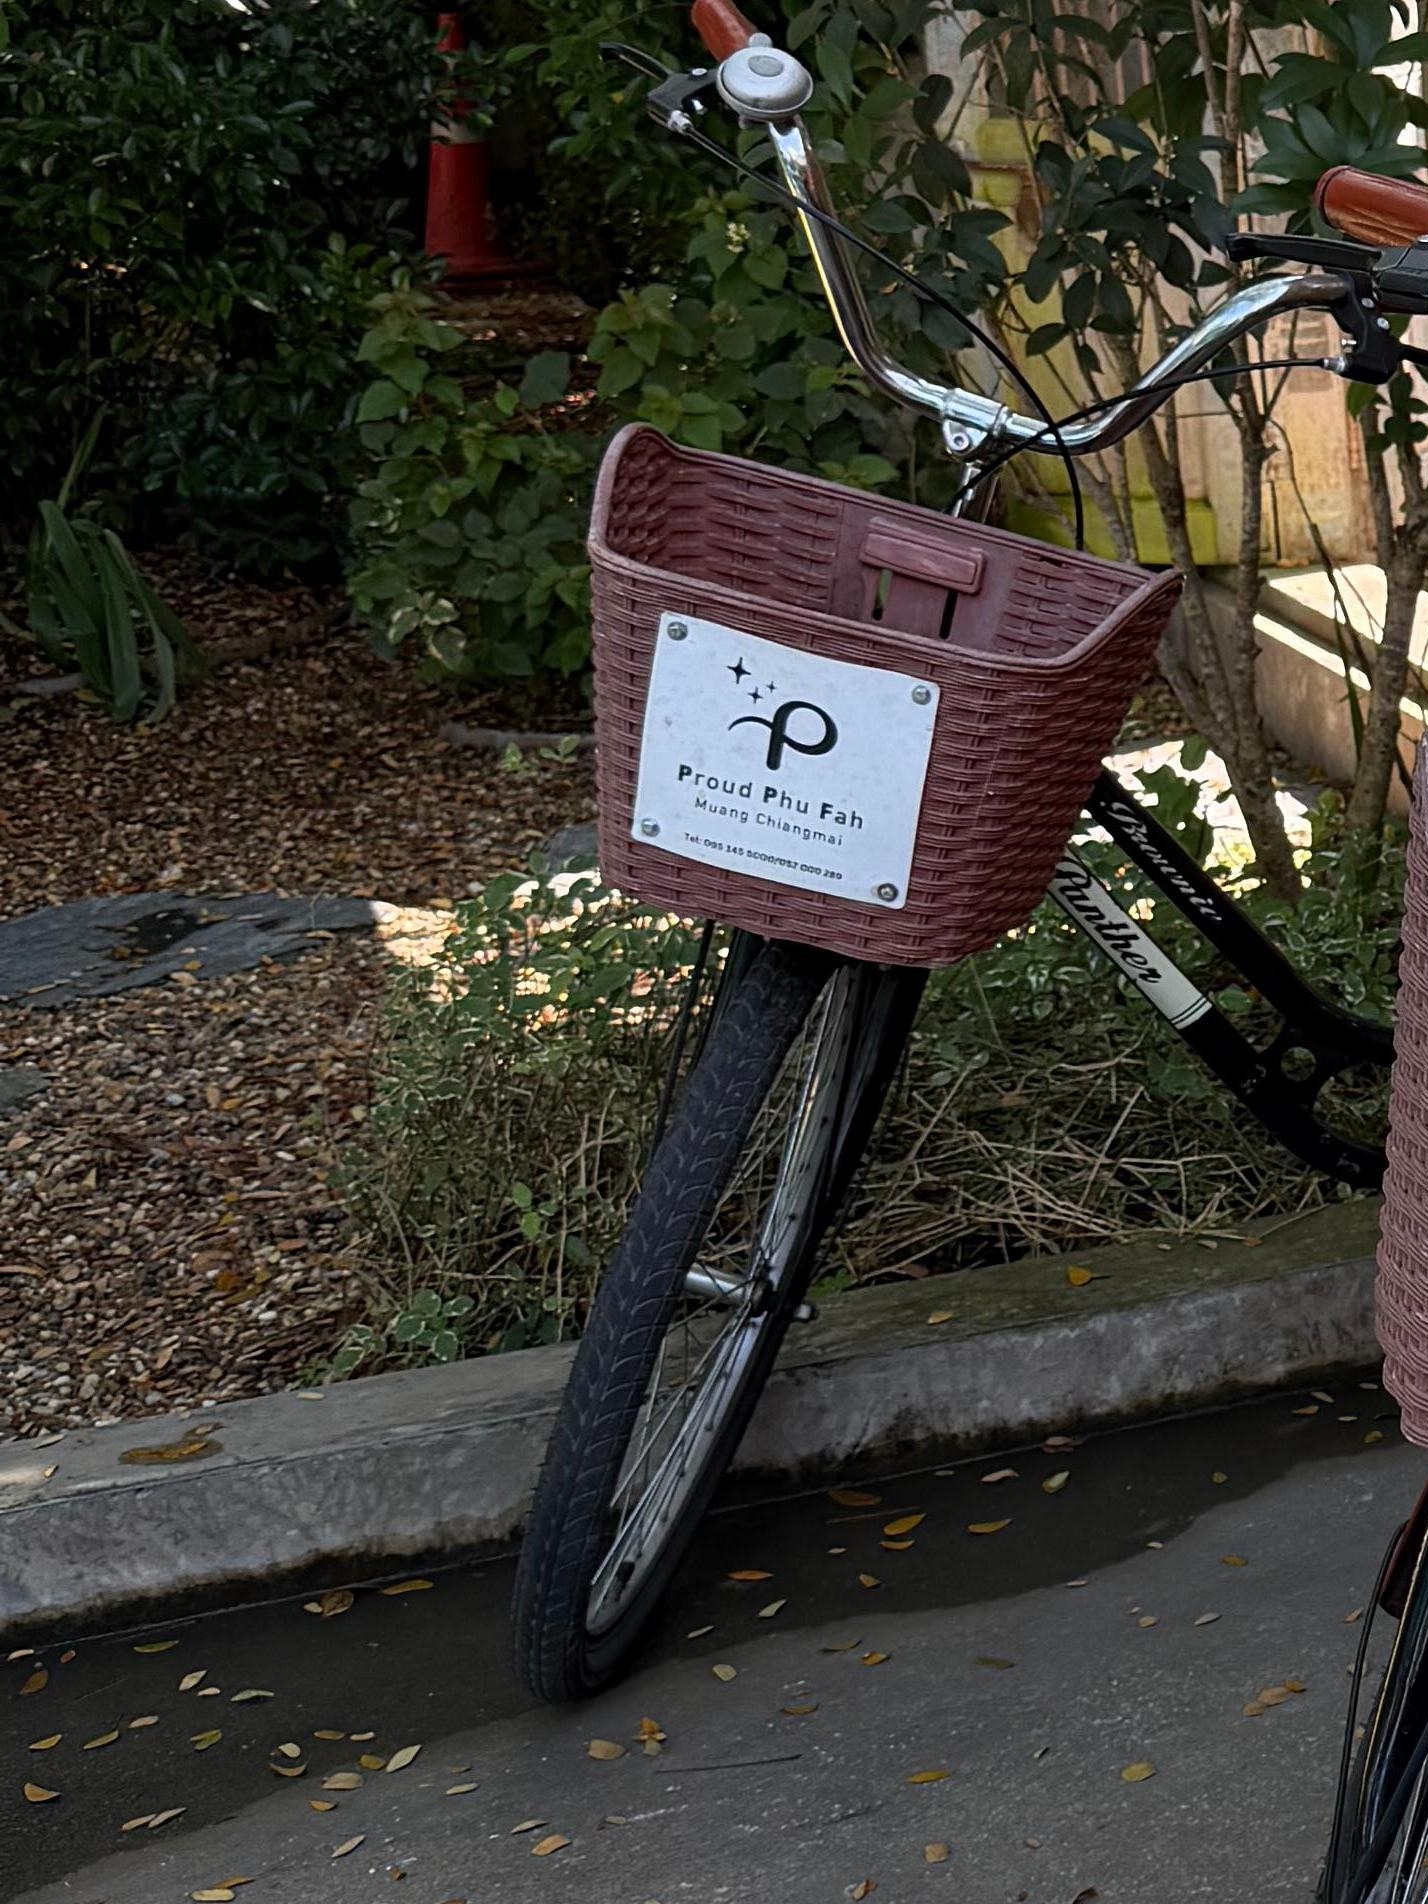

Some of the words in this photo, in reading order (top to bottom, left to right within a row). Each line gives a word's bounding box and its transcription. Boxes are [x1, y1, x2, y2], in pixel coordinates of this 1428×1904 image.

[678, 764, 753, 799] Proud
[762, 786, 810, 815] Phu
[819, 802, 864, 830] Fah
[694, 797, 749, 824] Muang
[756, 812, 843, 846] Chiangmai
[1055, 853, 1162, 984] Panther
